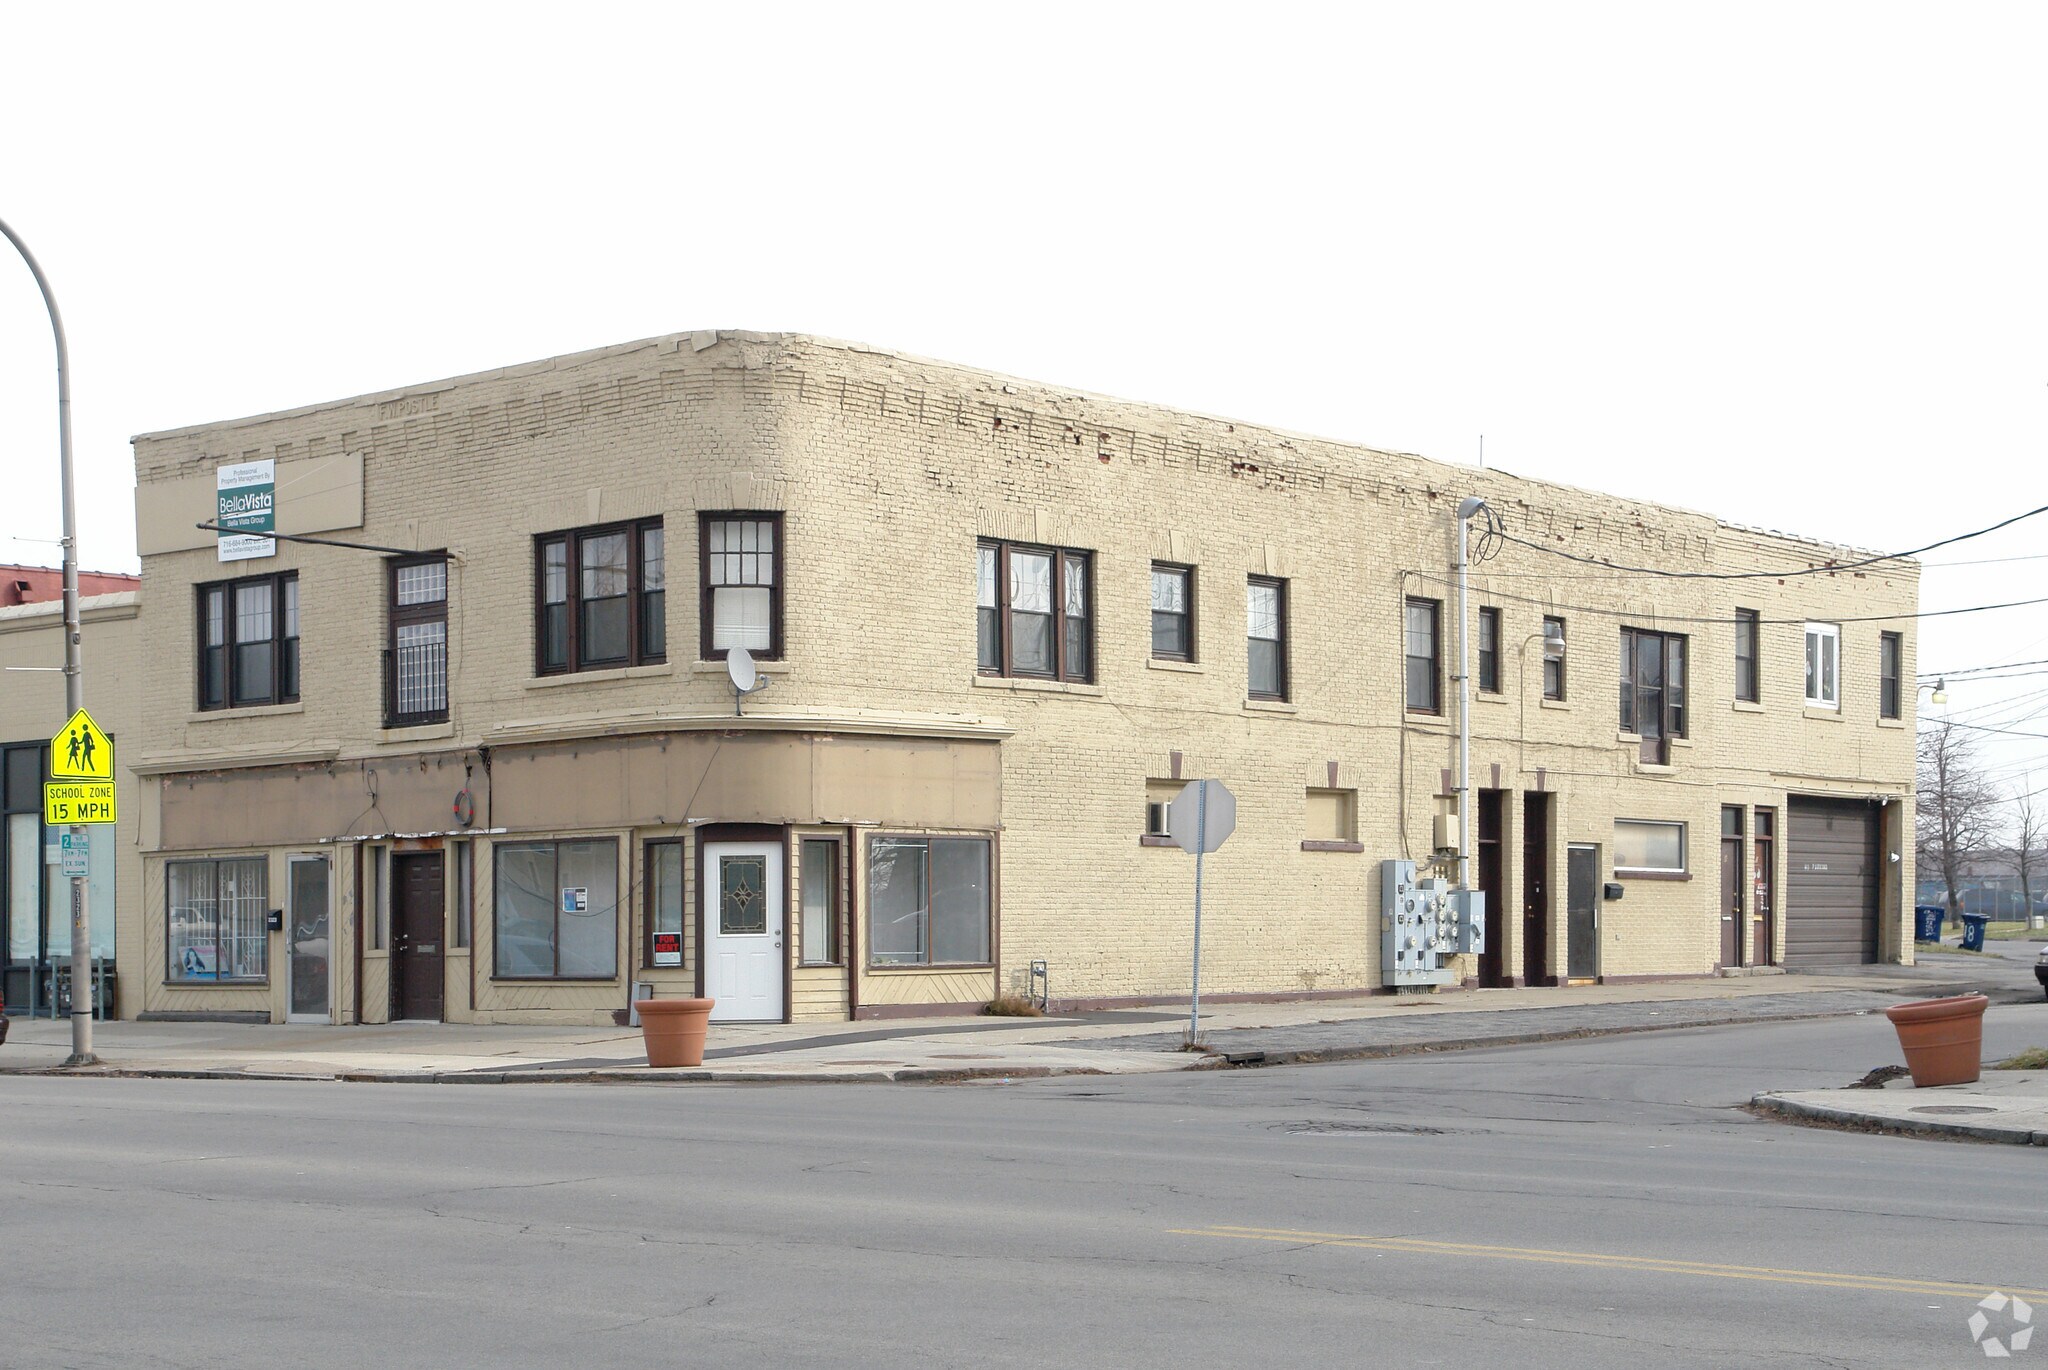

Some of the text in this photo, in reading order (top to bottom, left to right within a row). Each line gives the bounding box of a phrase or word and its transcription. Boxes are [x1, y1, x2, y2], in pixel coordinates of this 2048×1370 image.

[233, 467, 258, 477] Professional
[221, 472, 270, 485] Property Management By
[227, 516, 265, 527] Bella Vista Group
[50, 786, 112, 799] SCHOOL ZONE
[53, 803, 110, 819] 15 MPH
[63, 836, 70, 848] 2
[659, 935, 675, 943] FOR
[655, 943, 680, 952] RENT
